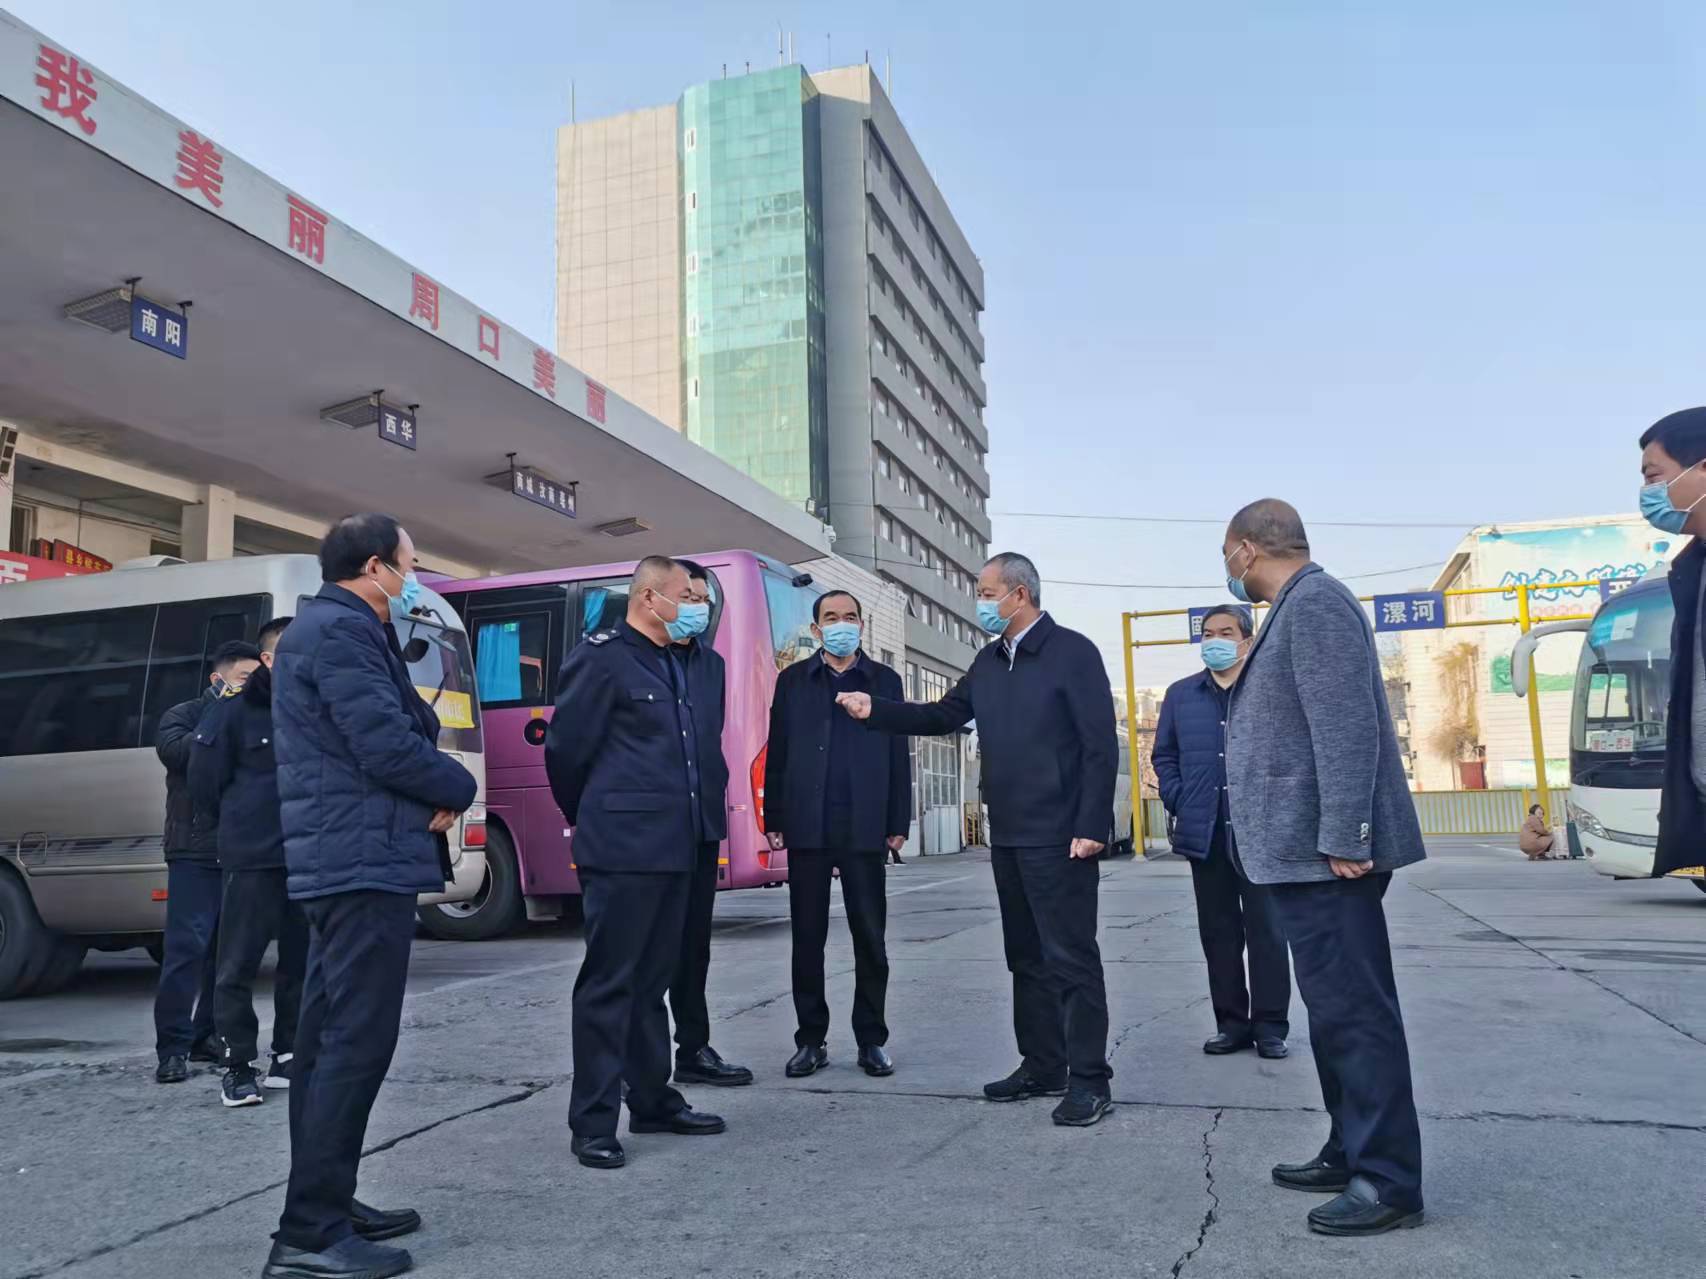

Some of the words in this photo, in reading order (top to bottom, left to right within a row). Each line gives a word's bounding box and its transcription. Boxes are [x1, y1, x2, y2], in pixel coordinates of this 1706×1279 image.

[141, 309, 181, 347] 南阳
[385, 412, 413, 441] 西华
[1382, 600, 1435, 625] 漯河
